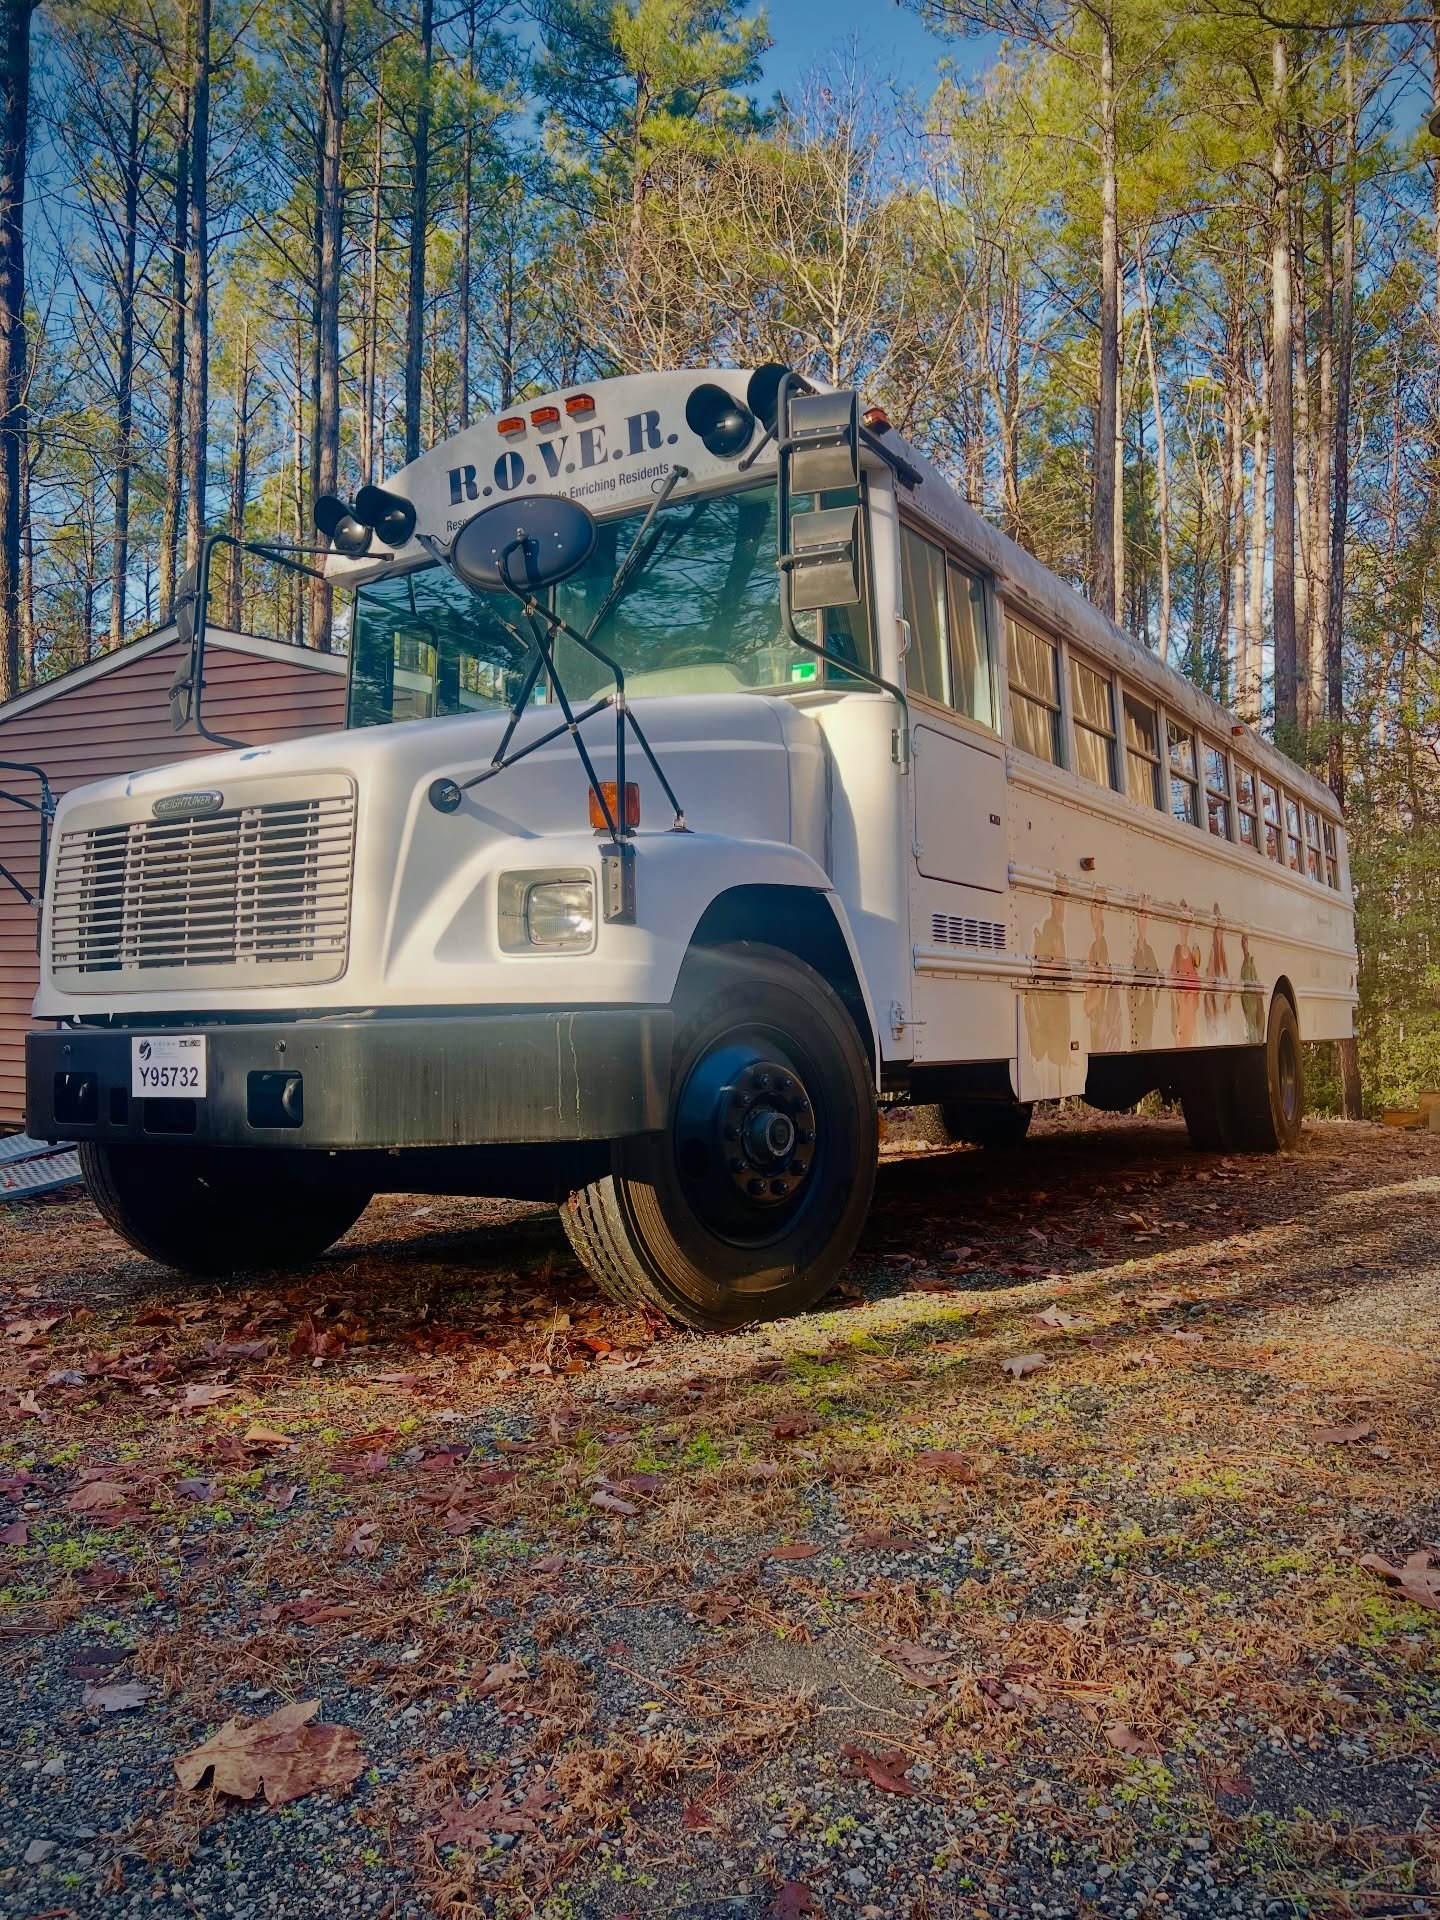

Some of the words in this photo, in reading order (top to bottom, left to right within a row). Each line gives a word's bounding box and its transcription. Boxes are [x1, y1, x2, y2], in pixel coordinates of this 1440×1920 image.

[447, 409, 679, 506] R.O.V.E.R.
[569, 477, 616, 499] Enriching
[619, 463, 669, 486] Residents
[139, 1066, 199, 1087] Y95732
